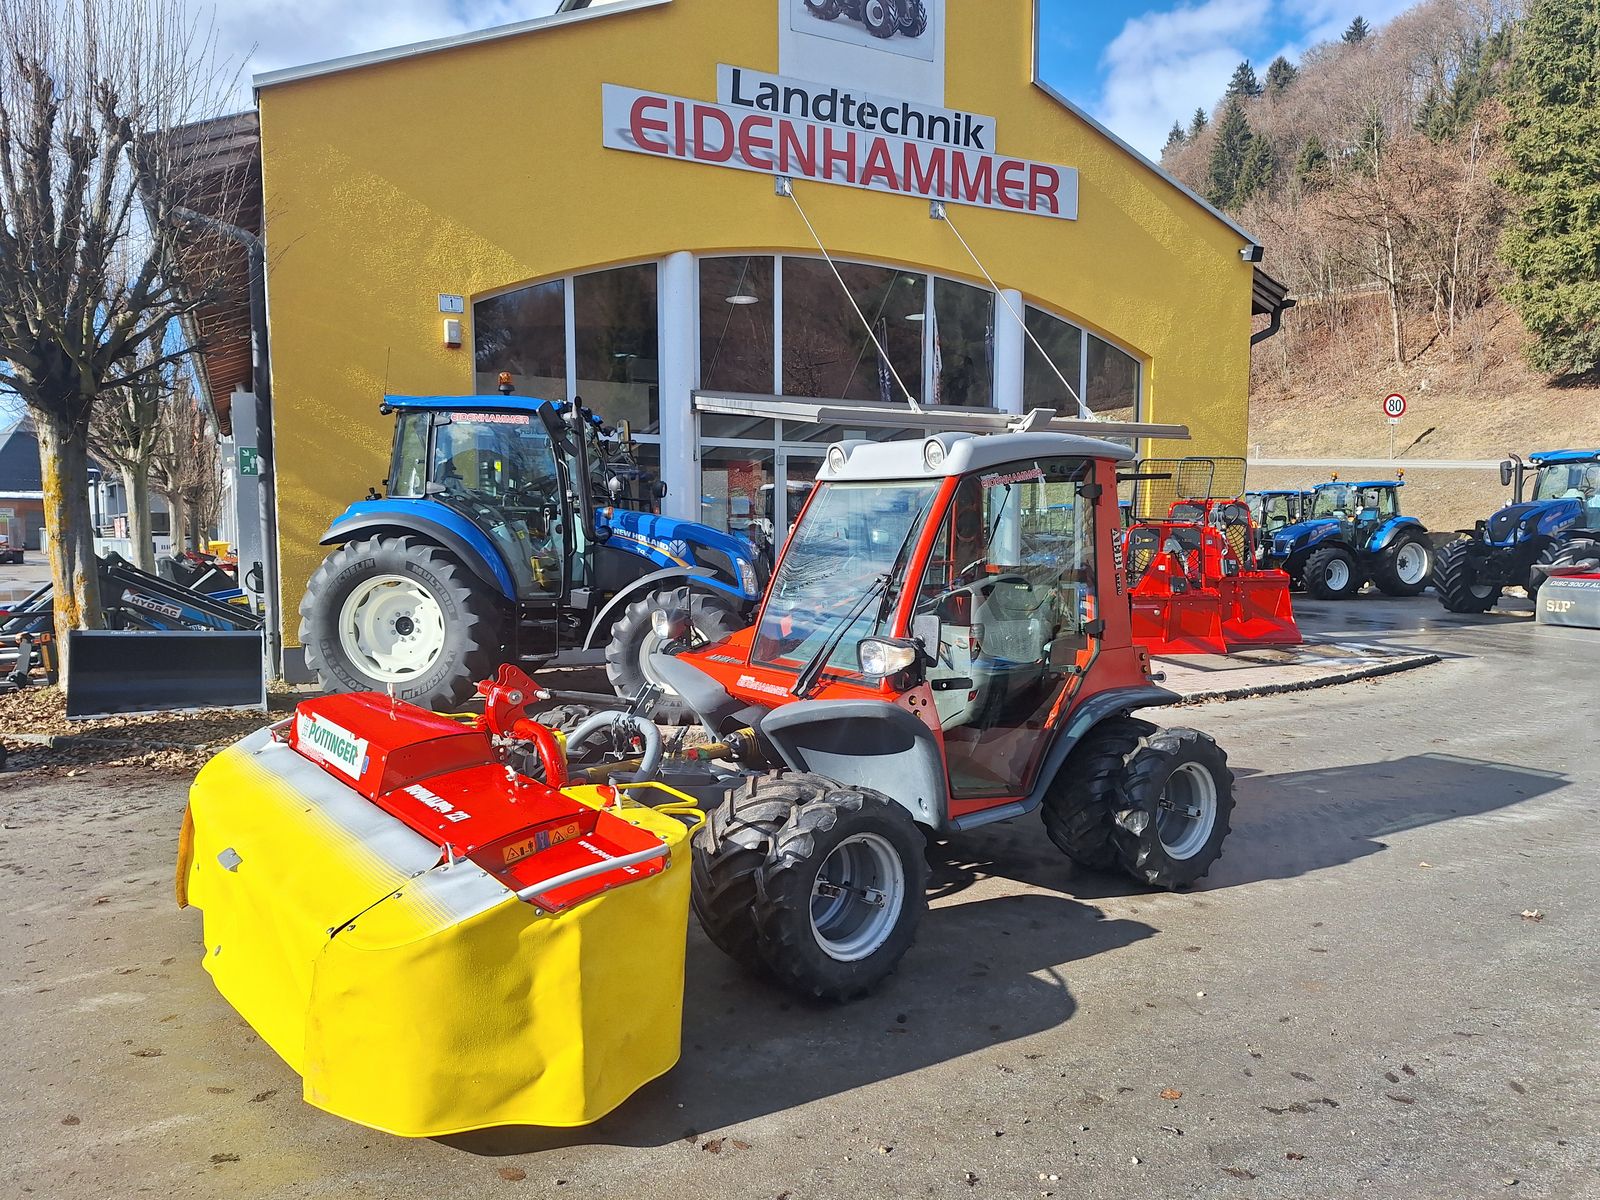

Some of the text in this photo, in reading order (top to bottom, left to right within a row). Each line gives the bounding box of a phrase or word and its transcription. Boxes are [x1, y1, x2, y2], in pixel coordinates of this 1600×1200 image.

[731, 68, 985, 150] Landtechnik
[629, 95, 1060, 215] EIDENHAMMER
[1388, 399, 1402, 412] 80
[451, 412, 530, 425] EIDENHAMMER
[613, 527, 669, 552] NEW HOLLAND
[1111, 528, 1124, 571] AEBI
[131, 596, 178, 617] HYDRAC
[1546, 599, 1571, 613] SIP
